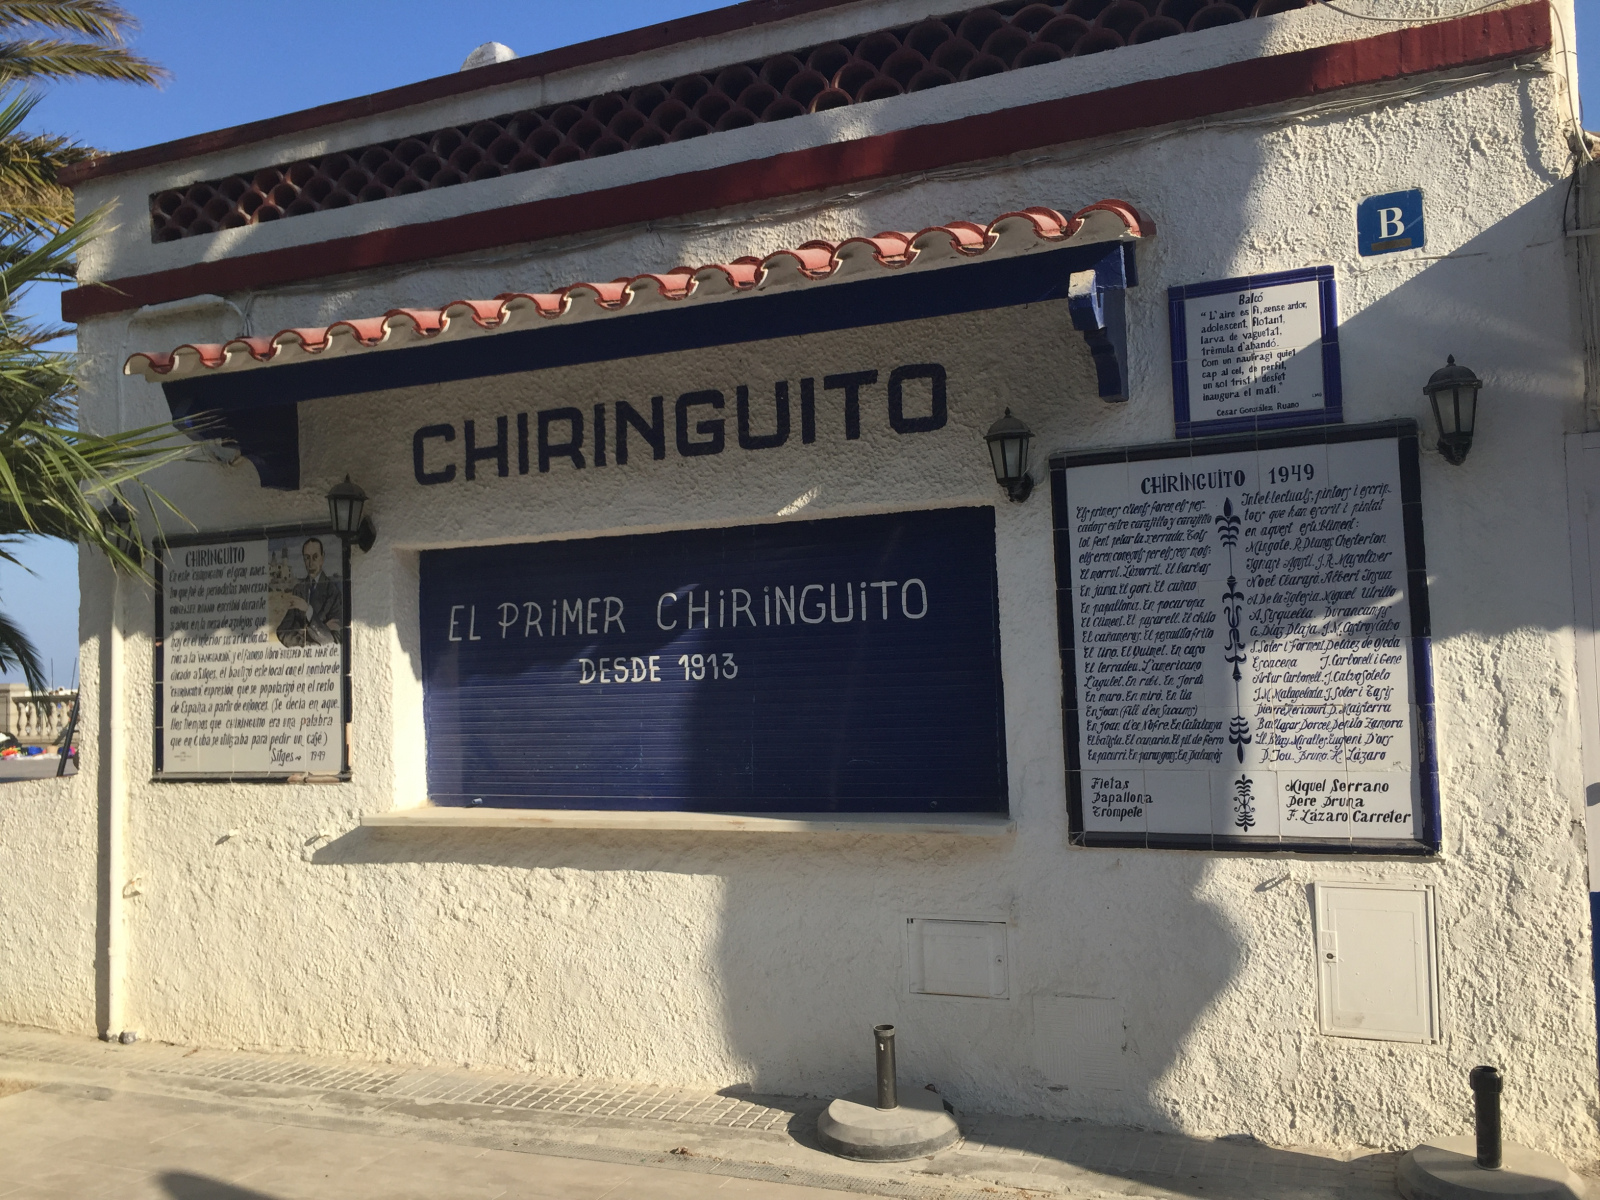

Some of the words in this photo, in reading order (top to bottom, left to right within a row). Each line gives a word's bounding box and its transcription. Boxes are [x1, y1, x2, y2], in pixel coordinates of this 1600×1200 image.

[1377, 207, 1405, 239] B
[1239, 292, 1263, 305] Balcó
[1264, 305, 1284, 313] sense
[1201, 336, 1225, 344] larva
[1229, 333, 1238, 341] de
[1202, 359, 1218, 367] Com
[1236, 352, 1272, 363] naufragi
[1277, 349, 1296, 361] quiet
[1202, 372, 1217, 381] cap
[1221, 368, 1228, 376] al
[1249, 365, 1257, 373] de
[1215, 380, 1227, 388] sol
[1231, 376, 1250, 386] trist
[1261, 372, 1286, 383] desfet
[1203, 392, 1240, 402] inaugura
[1244, 388, 1251, 396] el
[1277, 402, 1299, 410] Ruano
[412, 363, 947, 485] CHIRINGUITO
[1141, 469, 1246, 494] CHIRINGUITO
[1269, 464, 1314, 484] 1949
[185, 546, 245, 567] CHIRINGUITO
[449, 604, 481, 642] EL
[579, 655, 661, 686] DESDE
[678, 652, 739, 682] 1913
[1085, 691, 1096, 702] En
[1125, 691, 1138, 701] En
[299, 715, 333, 731] palabra
[251, 735, 268, 749] para
[269, 733, 291, 751] pedir
[271, 748, 294, 766] Sitges
[311, 751, 325, 760] 1949
[1330, 779, 1389, 794] Serrano
[1093, 806, 1142, 822] Trompete
[1300, 809, 1348, 824] Lázaro
[1353, 810, 1411, 823] Carreter
